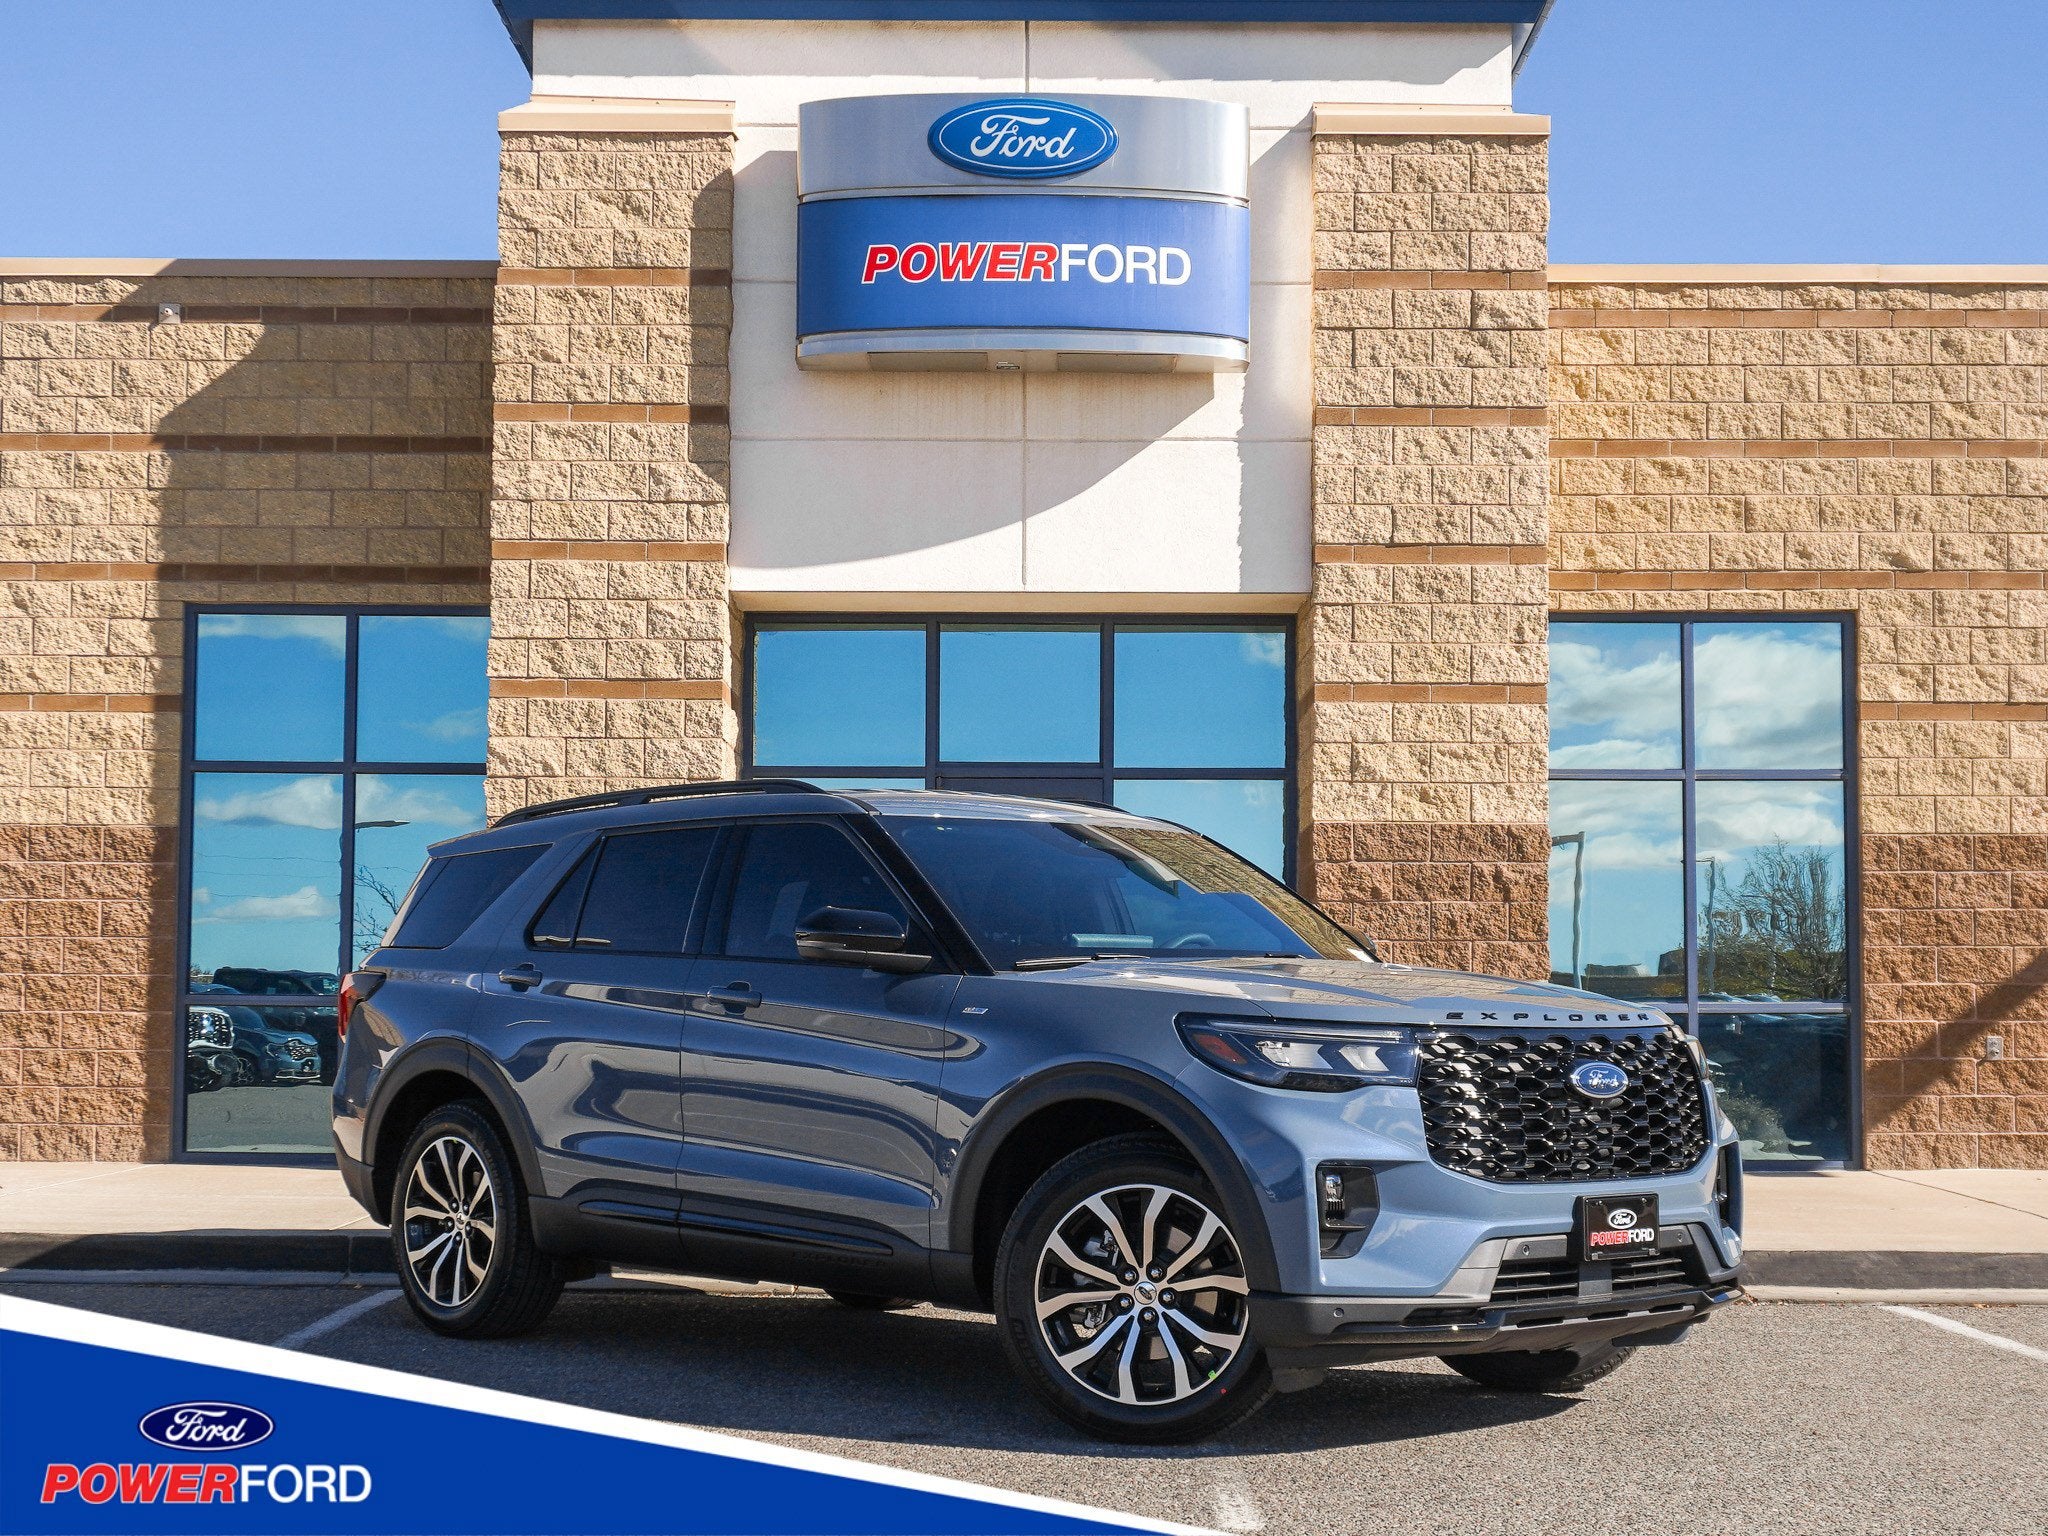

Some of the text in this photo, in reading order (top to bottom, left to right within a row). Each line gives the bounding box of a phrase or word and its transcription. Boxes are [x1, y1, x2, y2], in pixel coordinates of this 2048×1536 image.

[970, 114, 1076, 159] Ford
[1446, 1011, 1650, 1022] EXPLORER
[1612, 1213, 1632, 1225] Ford
